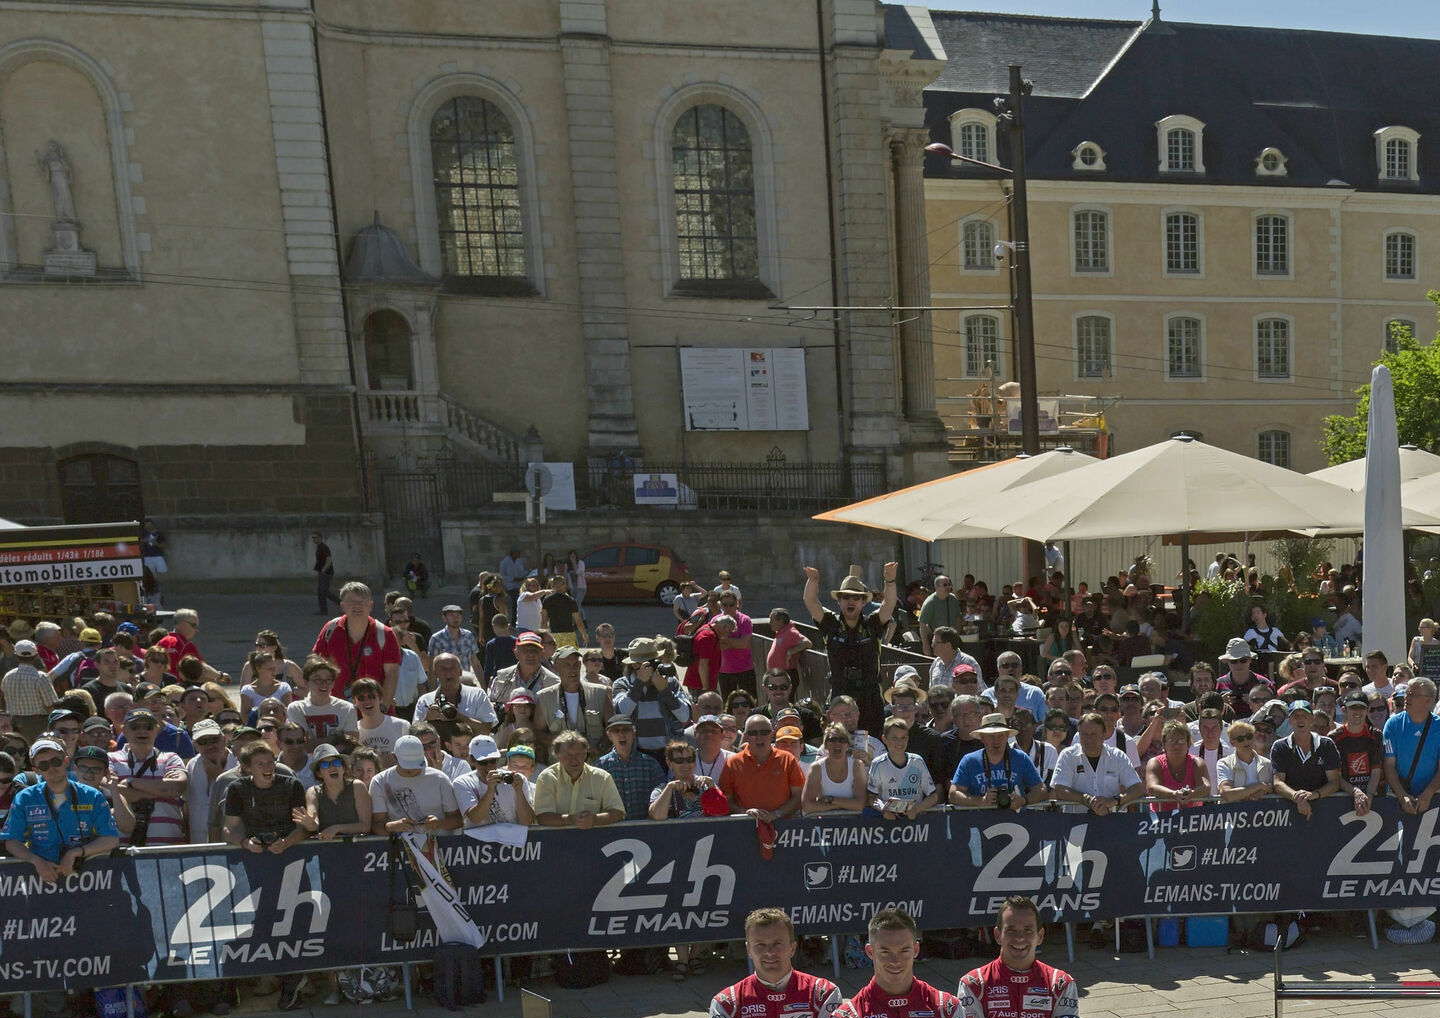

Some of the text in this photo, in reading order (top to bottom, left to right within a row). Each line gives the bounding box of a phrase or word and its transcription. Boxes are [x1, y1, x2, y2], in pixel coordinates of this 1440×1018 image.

[1137, 808, 1291, 836] 24H-LEMANS.COM
[972, 822, 1108, 892] 24h
[1200, 846, 1258, 866] #LM24
[591, 834, 735, 912] 24h
[837, 863, 898, 884] #LM24
[170, 858, 332, 945] 24h
[456, 883, 509, 906] LM24
[1143, 883, 1281, 904] LEMANS-TV.COM
[1322, 879, 1356, 899] LE
[3, 915, 77, 941] #LM24
[588, 909, 730, 936] LE MANS
[167, 938, 326, 967] LE MANS
